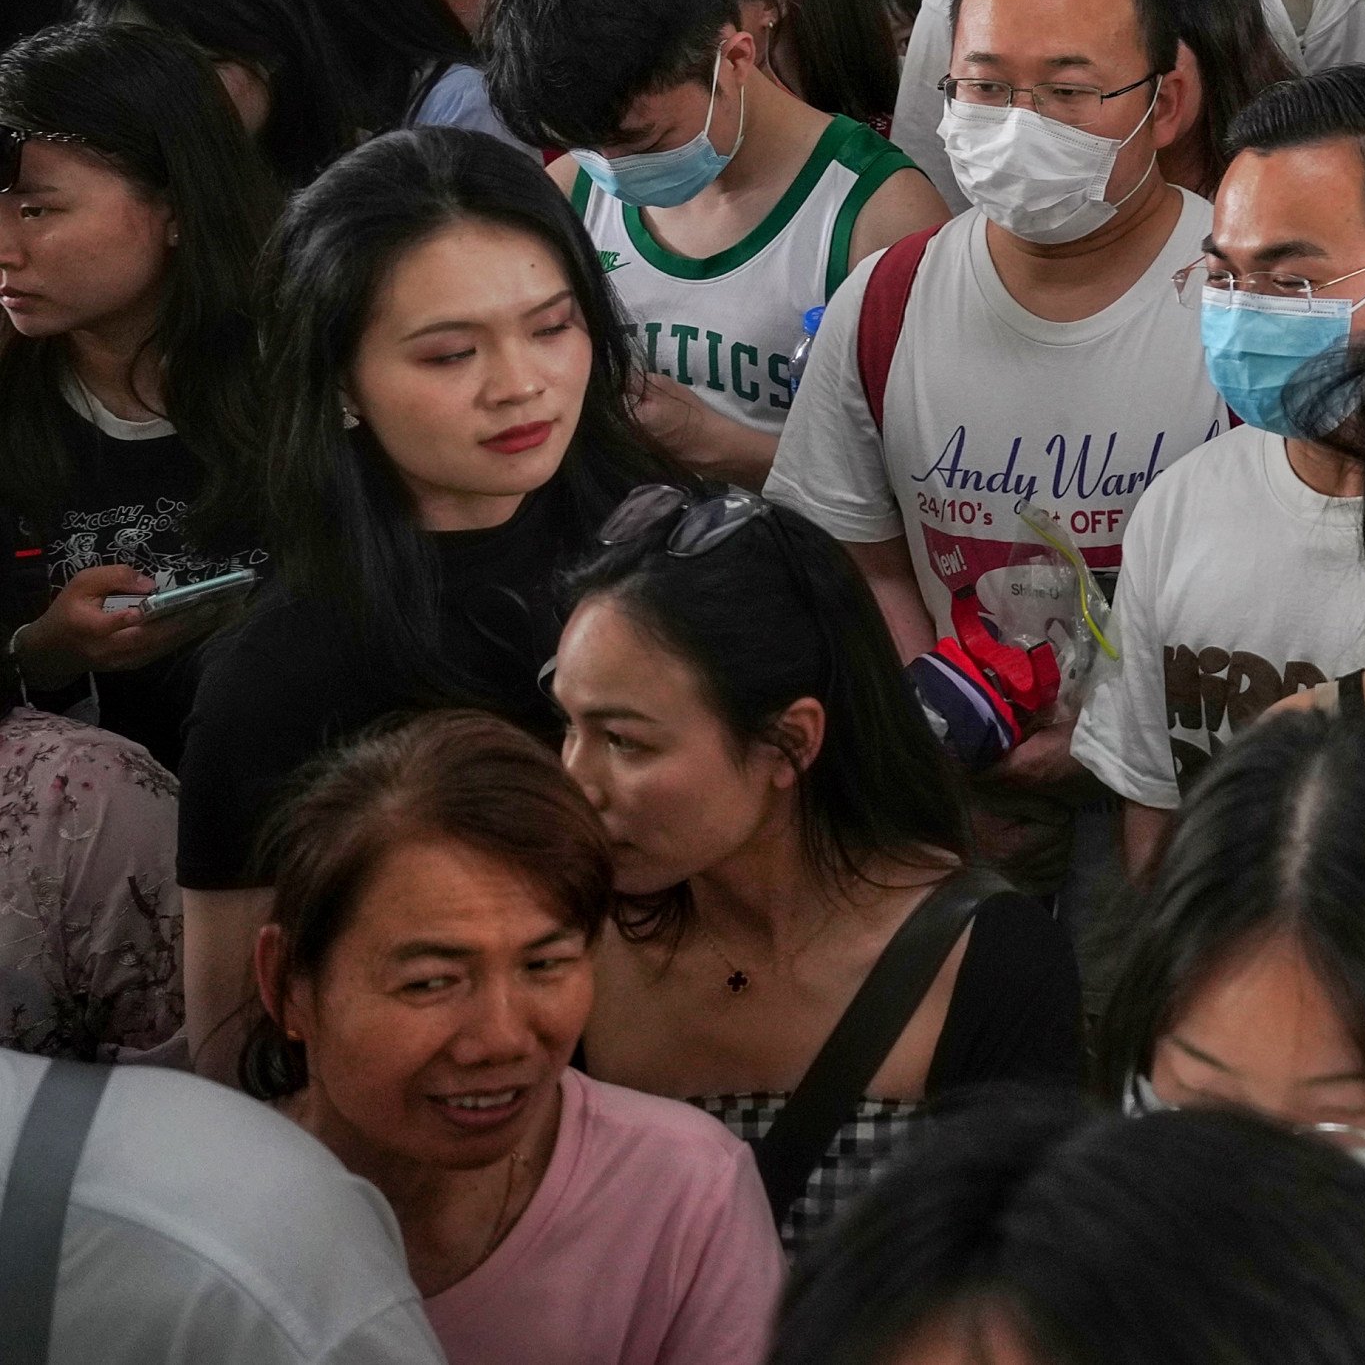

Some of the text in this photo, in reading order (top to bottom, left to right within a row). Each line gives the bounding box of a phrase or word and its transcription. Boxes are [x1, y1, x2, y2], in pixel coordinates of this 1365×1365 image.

[623, 322, 792, 410] LTICS
[911, 425, 1038, 515] Andy
[1070, 509, 1124, 534] OFF
